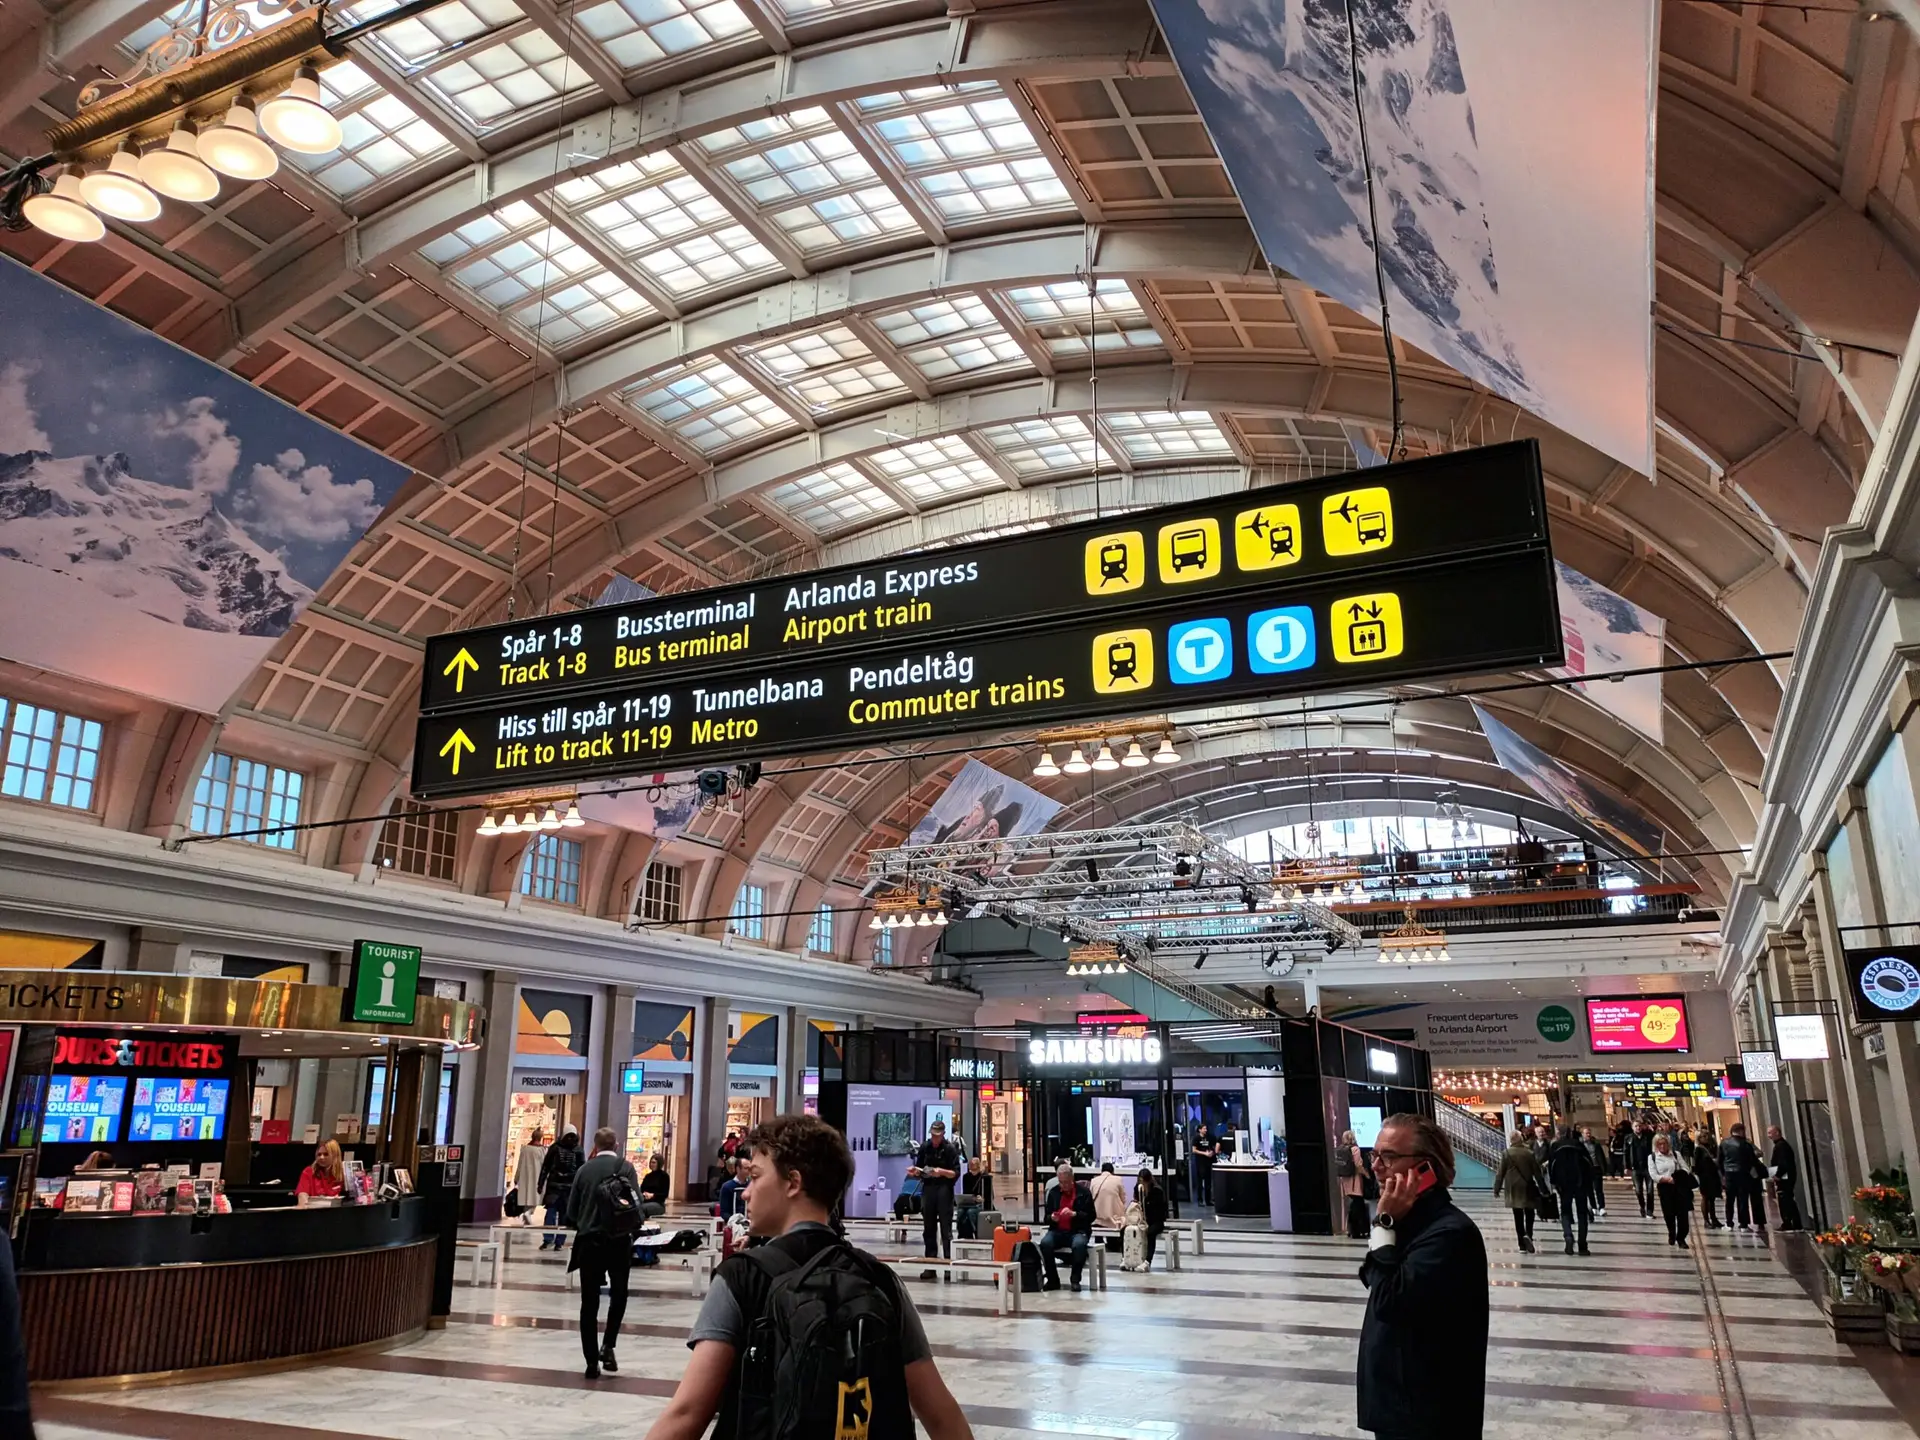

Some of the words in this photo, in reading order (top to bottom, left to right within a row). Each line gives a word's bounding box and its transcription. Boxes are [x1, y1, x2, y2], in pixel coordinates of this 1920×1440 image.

[784, 575, 875, 611] Arlanda
[886, 562, 977, 596] Express
[617, 594, 755, 639] Bussterminal
[783, 609, 867, 643] Airport
[875, 598, 931, 627] train
[502, 633, 546, 661] Spår
[553, 625, 582, 647] 1-8
[615, 646, 651, 668] Bus
[659, 626, 749, 661] terminal
[500, 657, 550, 685] Track
[558, 652, 586, 676] 1-8
[850, 651, 973, 691] Pendeltåg
[693, 678, 823, 712] Tunnelbana
[849, 689, 980, 724] Commuter
[988, 675, 1064, 705] trains
[499, 715, 536, 739] Hiss
[542, 707, 567, 733] till
[572, 702, 616, 734] spår
[623, 694, 671, 722] 11-19
[692, 718, 758, 744] Metro
[496, 743, 528, 769] Lift
[534, 744, 554, 764] to
[562, 732, 613, 760] track
[622, 725, 671, 752] 11-19
[368, 946, 414, 960] TOURIST
[1865, 961, 1915, 982] ESPRESSO
[1875, 993, 1914, 1006] HOUSE
[362, 1009, 406, 1018] INFORMATION
[1427, 1013, 1466, 1022] Frequent
[1467, 1012, 1518, 1021] departures
[1428, 1026, 1437, 1034] to
[1438, 1025, 1474, 1034] Arlanda
[1475, 1024, 1508, 1034] Airport
[1556, 1023, 1570, 1033] 119
[1029, 1039, 1161, 1064] SAMSUNG
[522, 1076, 566, 1087] PRESSBYRÅN
[643, 1079, 674, 1089] RESSBYRÅN
[730, 1082, 760, 1091] PRESSBYRÅN
[46, 1102, 99, 1113] OUSEUM
[154, 1103, 206, 1113] YOUSEUM
